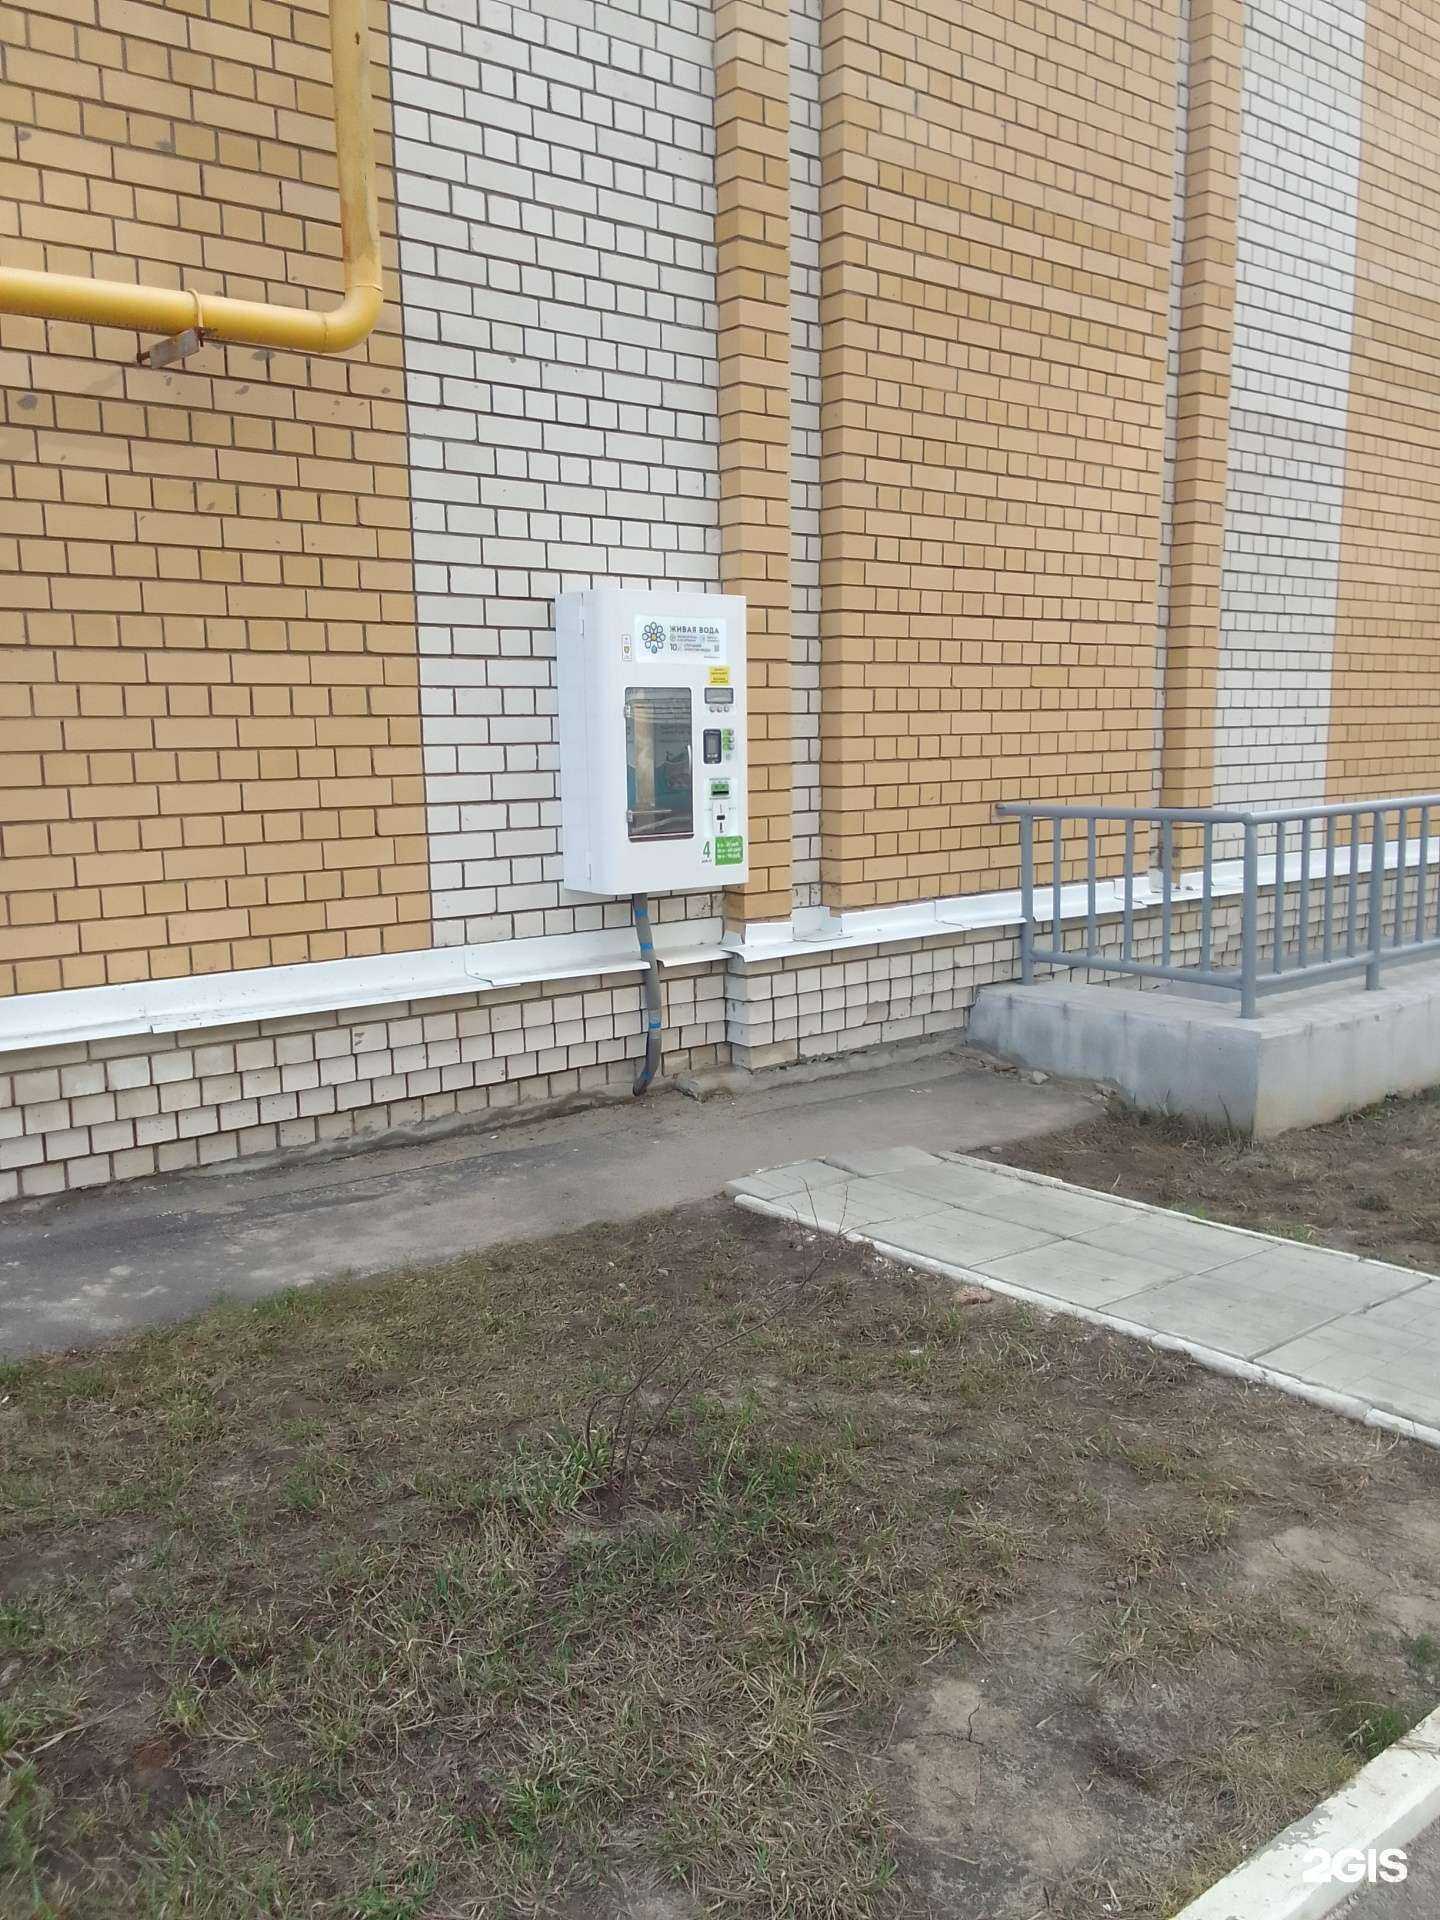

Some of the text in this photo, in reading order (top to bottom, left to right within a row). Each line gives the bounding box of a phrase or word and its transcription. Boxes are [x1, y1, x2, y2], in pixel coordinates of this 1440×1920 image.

[669, 625, 720, 634] ЖИВАЯ ВОДА
[669, 643, 678, 651] 10
[702, 840, 711, 858] 4
